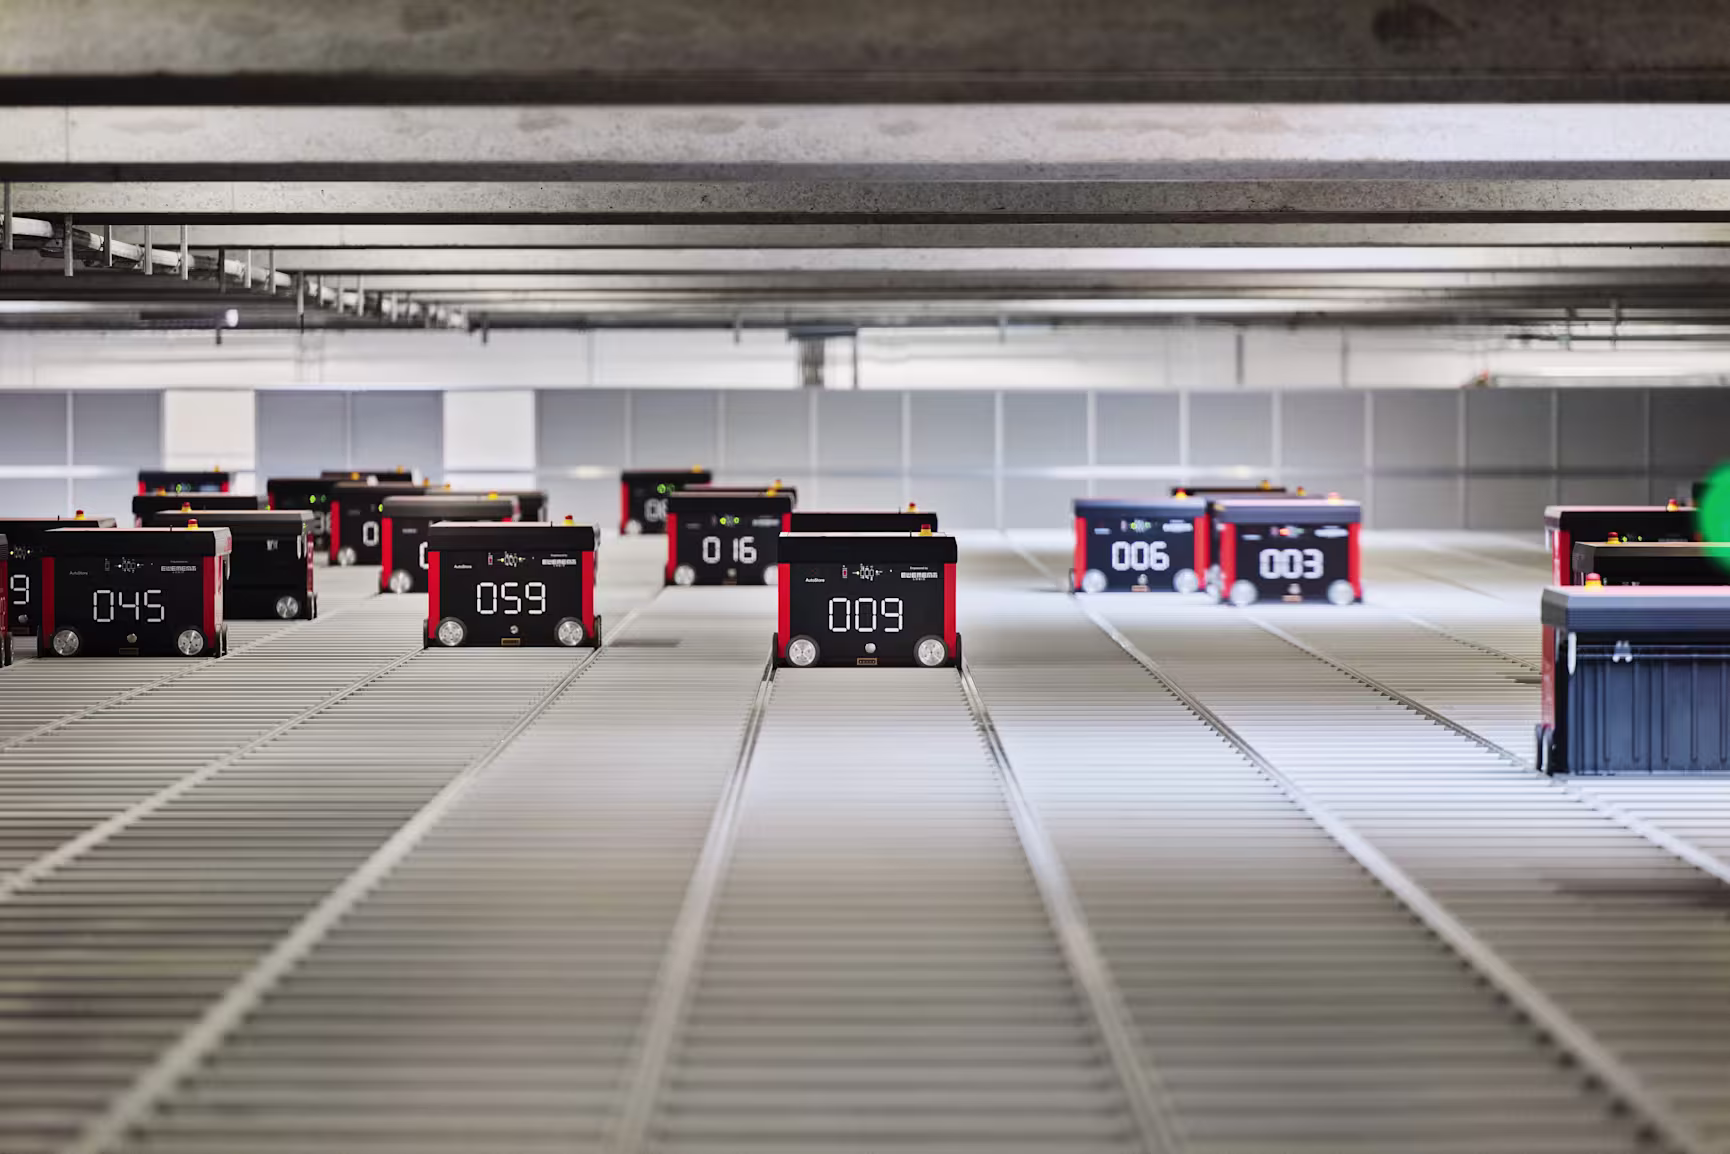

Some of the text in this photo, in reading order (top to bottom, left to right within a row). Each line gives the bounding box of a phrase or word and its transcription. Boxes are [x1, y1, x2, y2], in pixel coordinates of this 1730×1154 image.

[1111, 541, 1170, 571] 006
[1258, 548, 1324, 579] 003
[93, 589, 165, 622] 045
[476, 582, 546, 615] 059
[828, 597, 903, 632] 009
